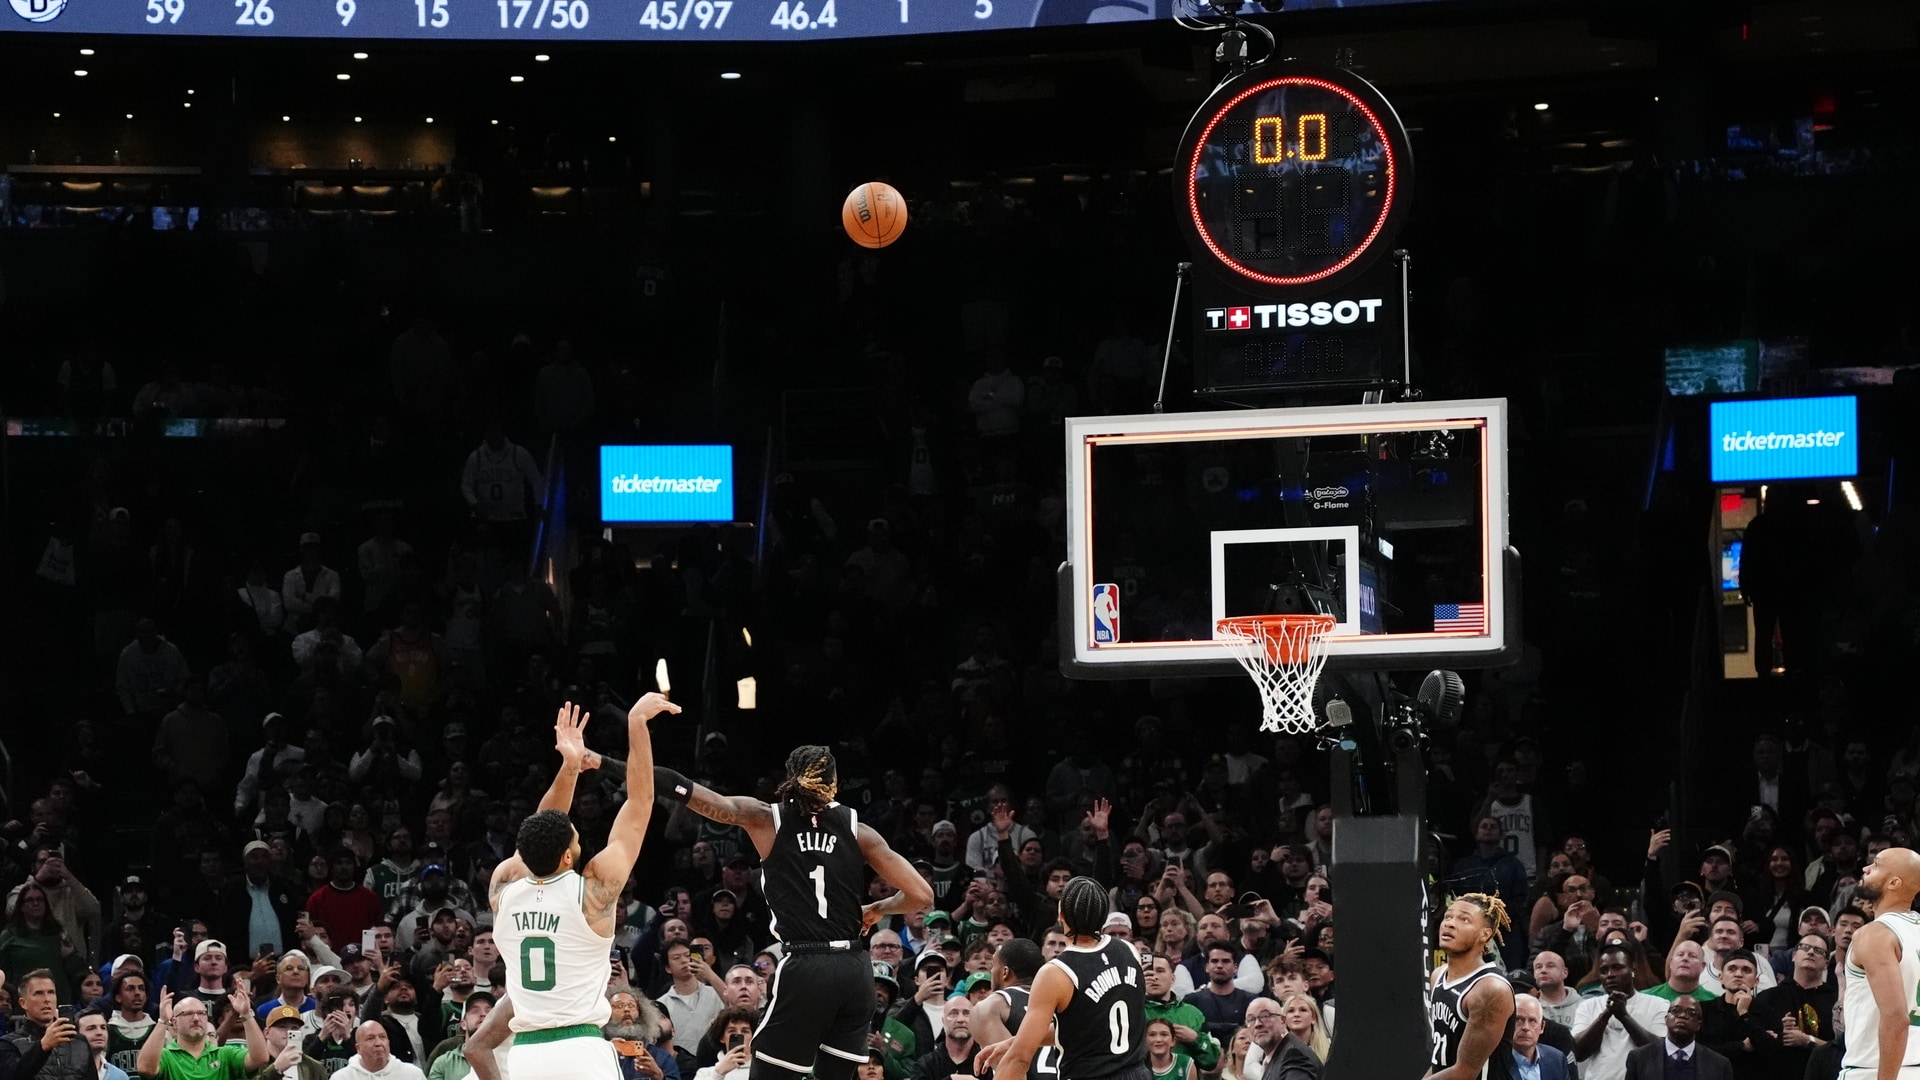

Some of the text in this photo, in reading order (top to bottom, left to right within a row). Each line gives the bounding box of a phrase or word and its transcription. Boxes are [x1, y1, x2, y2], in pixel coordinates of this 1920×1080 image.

[145, 0, 185, 24] 59
[235, 0, 275, 26] 26
[335, 0, 357, 27] 9
[414, 0, 450, 28] 15
[498, 0, 589, 29] 17/50
[639, 0, 733, 30] 45/97
[770, 0, 838, 31] 46.4
[1254, 113, 1328, 165] 0.0
[1253, 298, 1383, 329] TISSOT
[1722, 430, 1845, 452] ticketmaster
[611, 473, 722, 494] ticketmaster
[1313, 501, 1350, 510] G-Flame
[1096, 629, 1110, 641] NBA
[796, 831, 838, 854] ELLIS
[808, 864, 828, 919] 1
[512, 911, 561, 934] TATUM
[520, 936, 557, 992] 0
[1084, 965, 1138, 1004] BROWN JR.
[1108, 1000, 1130, 1055] 0
[1431, 1031, 1448, 1067] 21
